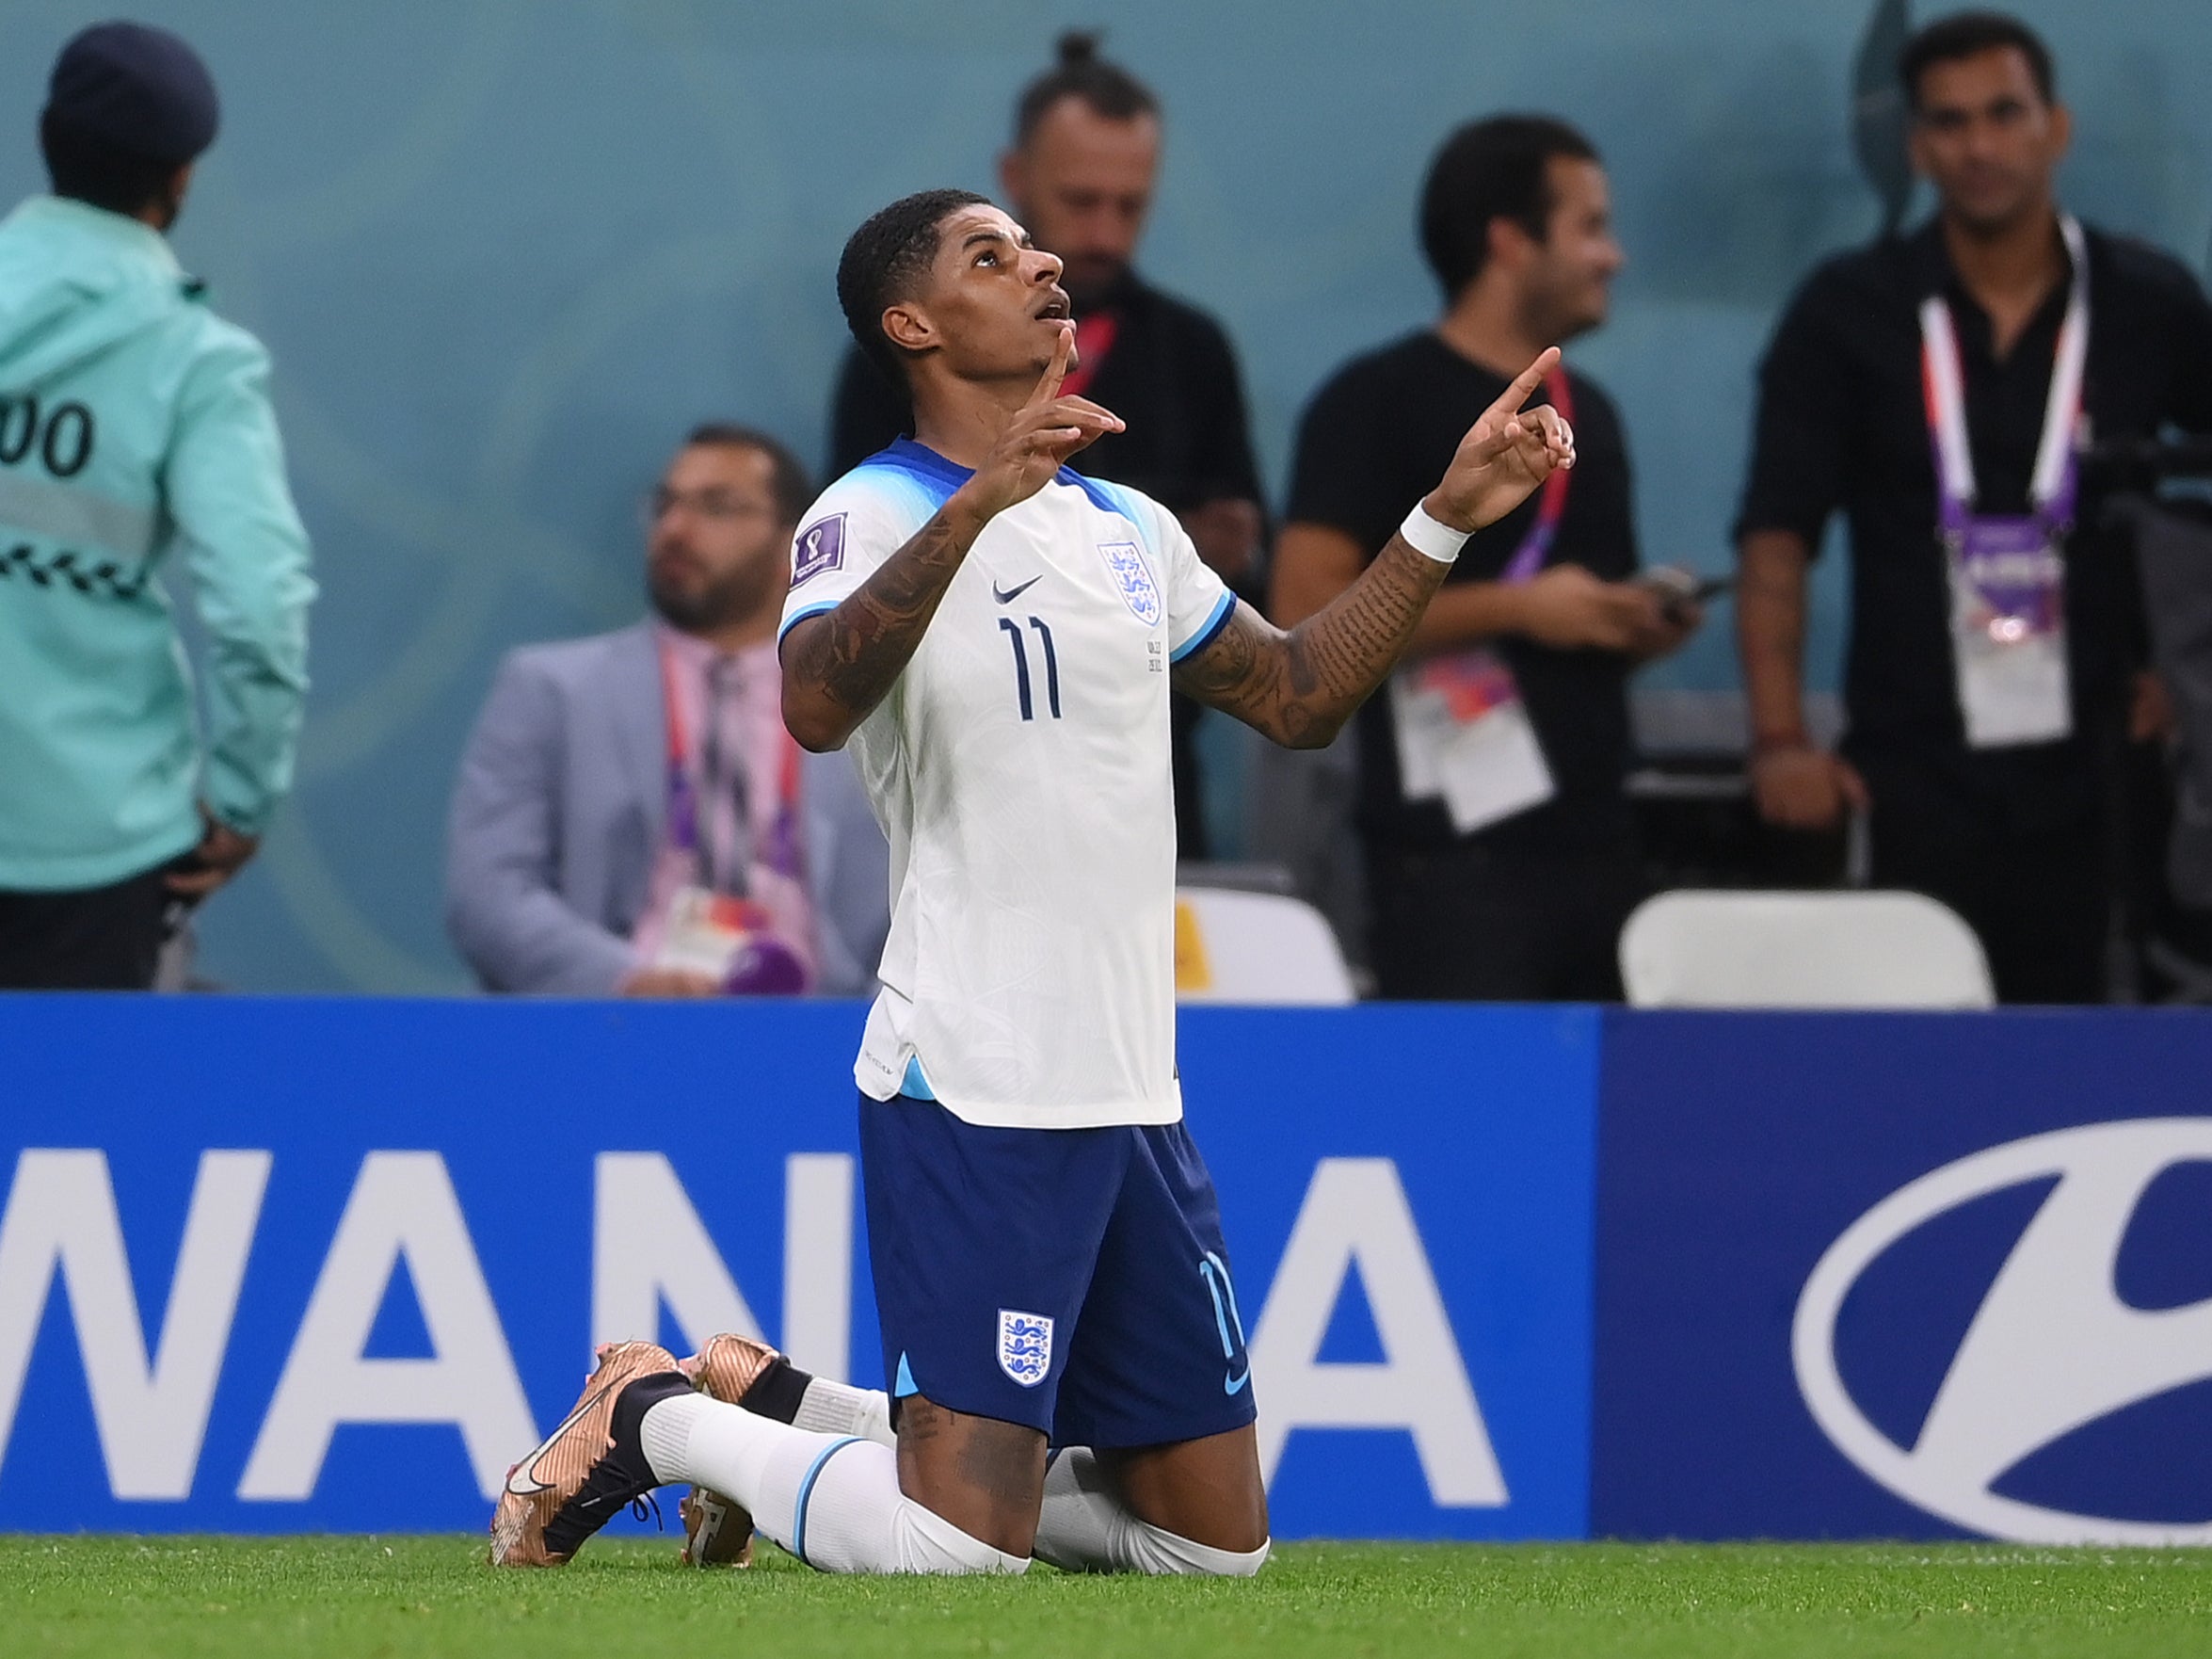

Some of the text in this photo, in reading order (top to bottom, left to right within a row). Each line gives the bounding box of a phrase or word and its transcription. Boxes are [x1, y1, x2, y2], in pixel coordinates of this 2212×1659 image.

[998, 616, 1062, 721] 11
[0, 1148, 1510, 1507] WANA
[1199, 1250, 1246, 1360] 11
